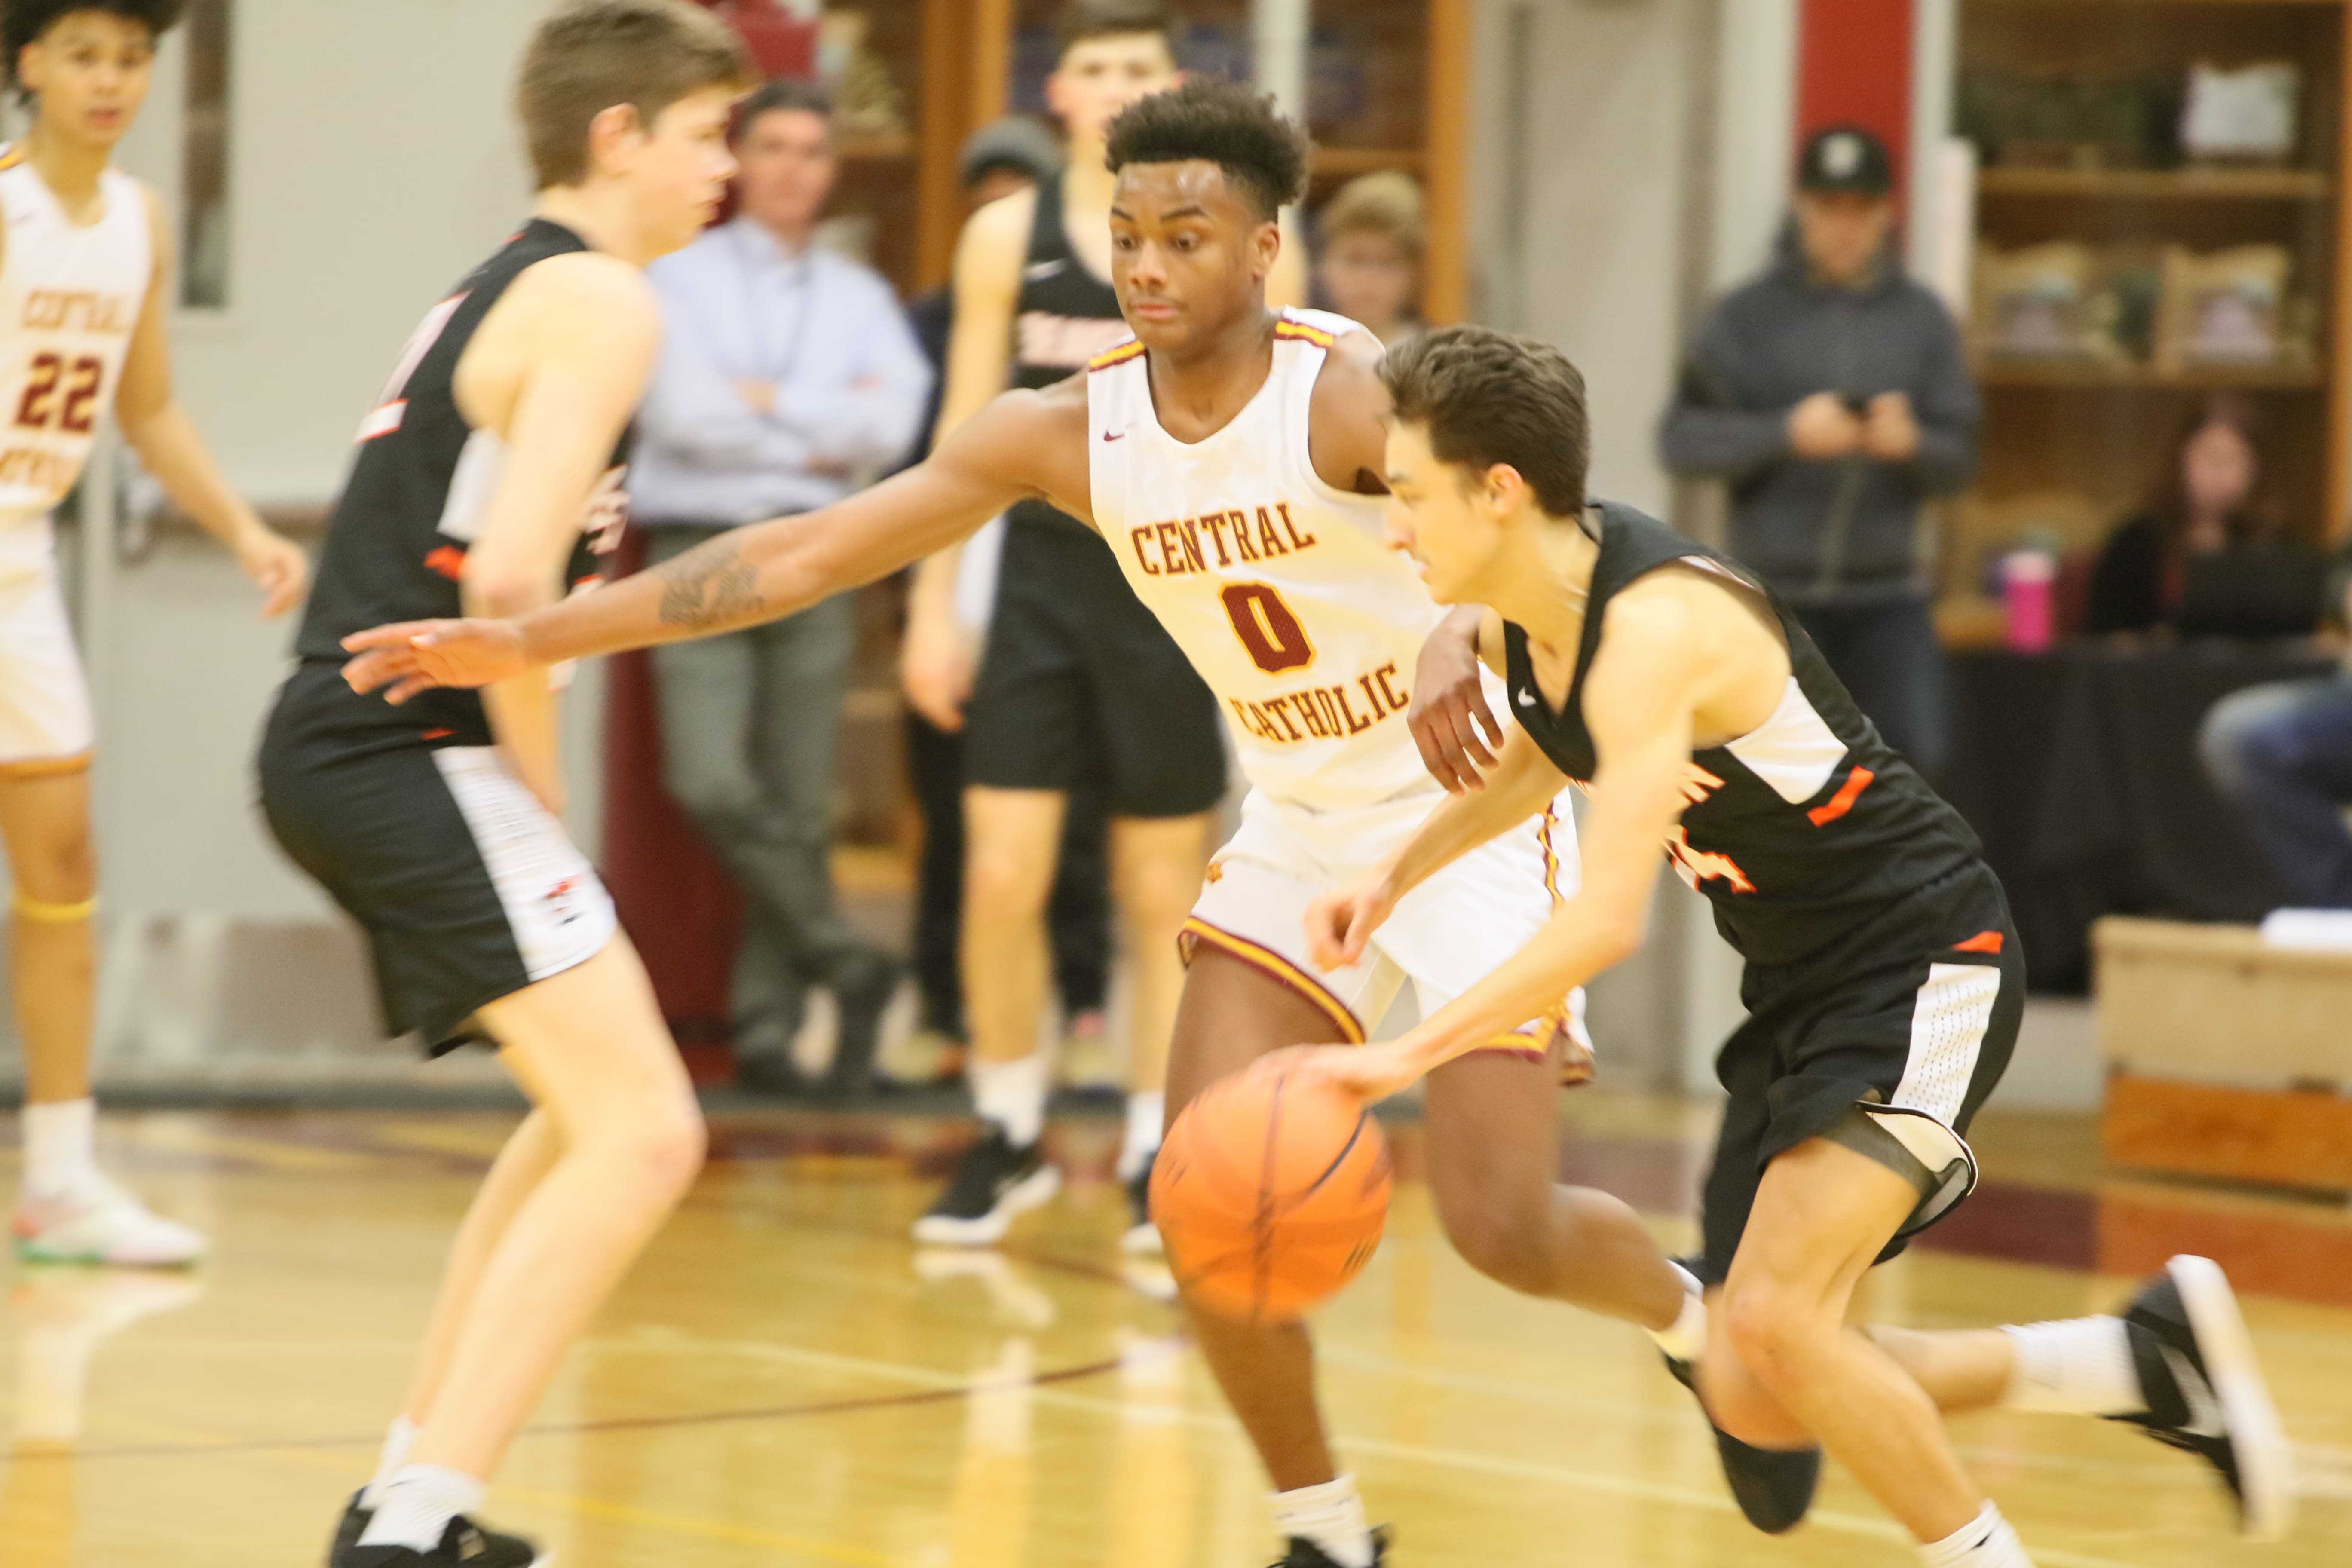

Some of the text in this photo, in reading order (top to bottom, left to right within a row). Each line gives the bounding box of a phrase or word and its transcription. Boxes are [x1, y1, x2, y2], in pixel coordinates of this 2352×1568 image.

[12, 350, 103, 435] 22
[1130, 502, 1318, 576] CENTRAL
[1229, 661, 1410, 744] CATHOLIC
